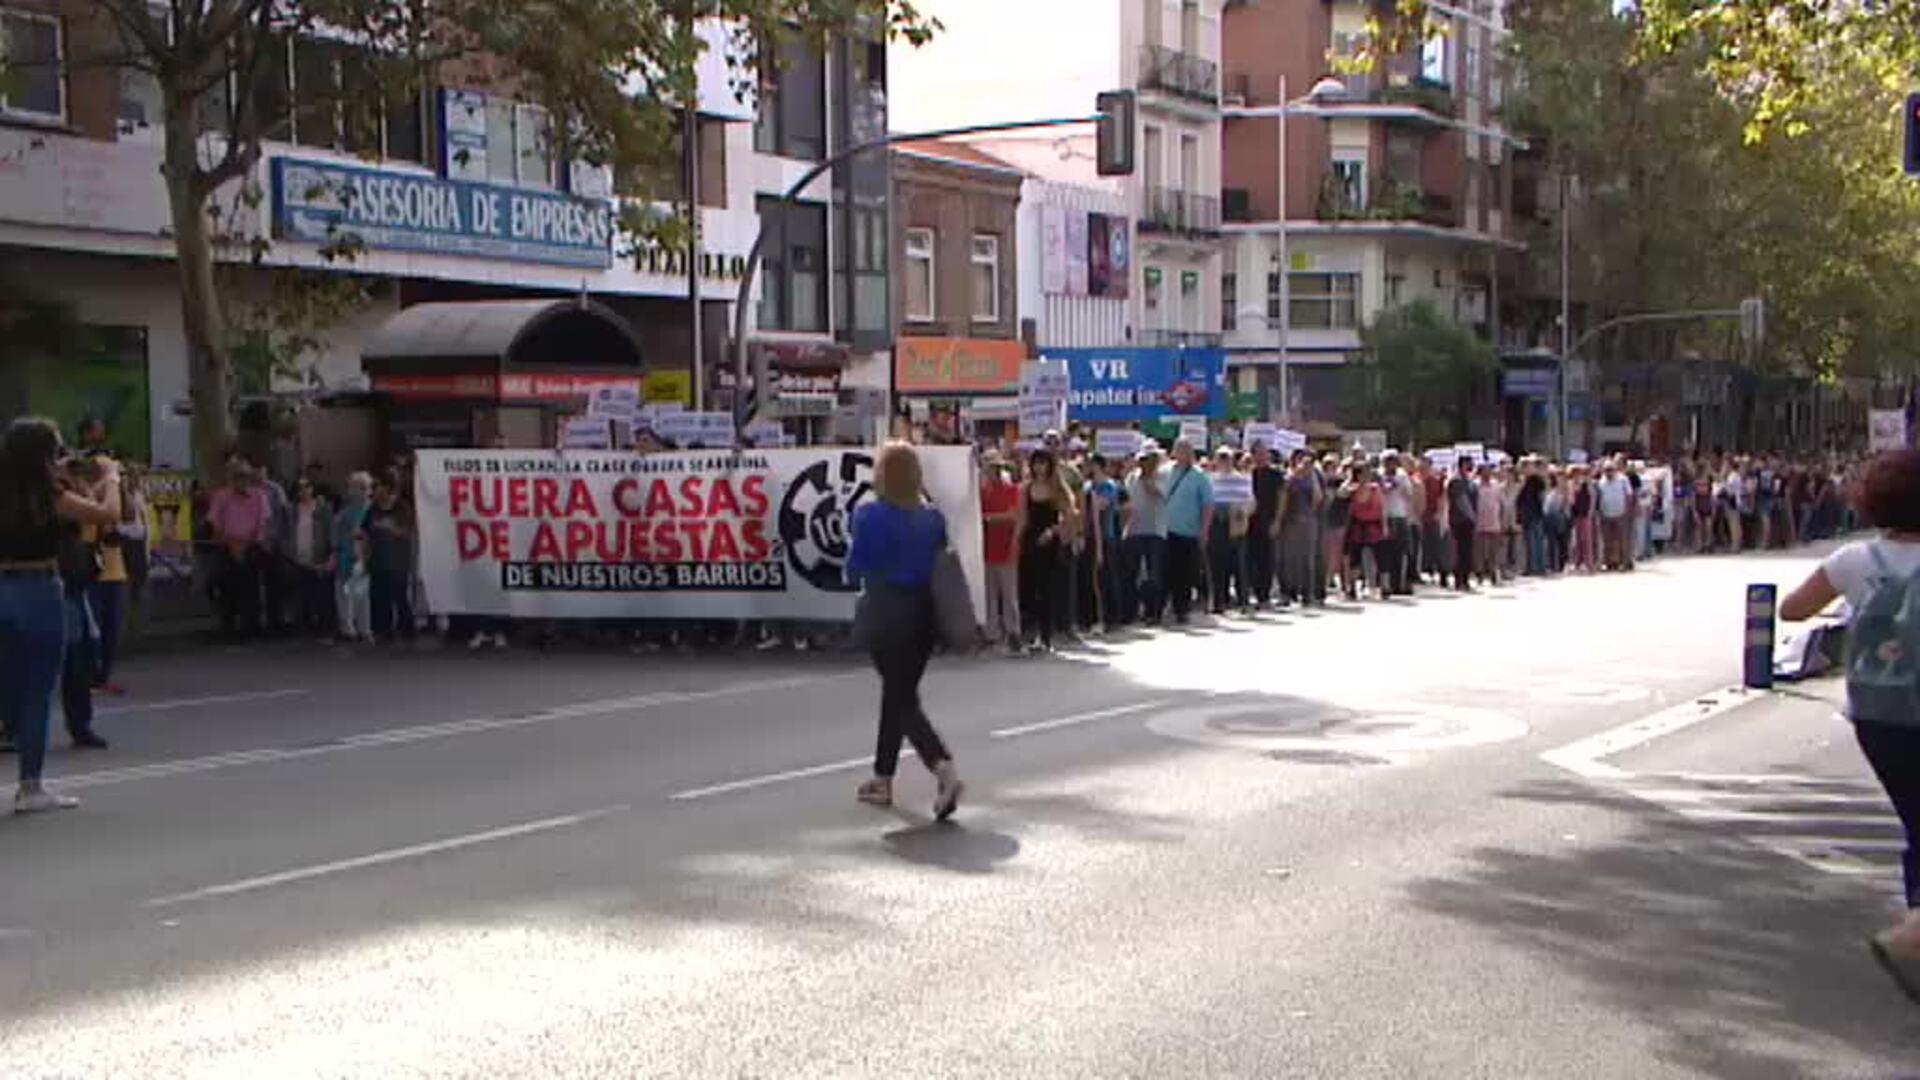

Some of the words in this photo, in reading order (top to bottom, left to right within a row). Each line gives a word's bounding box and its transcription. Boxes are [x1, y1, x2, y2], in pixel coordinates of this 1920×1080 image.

[347, 176, 461, 233] ASESORIA
[471, 189, 500, 233] DE
[511, 194, 608, 247] EMPRESAS
[1090, 359, 1129, 379] VR
[449, 478, 599, 518] FUERA
[612, 475, 769, 518] CASAS
[457, 520, 510, 563] DE
[527, 519, 770, 564] APUESTAS
[506, 565, 535, 586] DE
[541, 564, 669, 588] NUESTROS
[677, 564, 782, 586] BARRIOS
